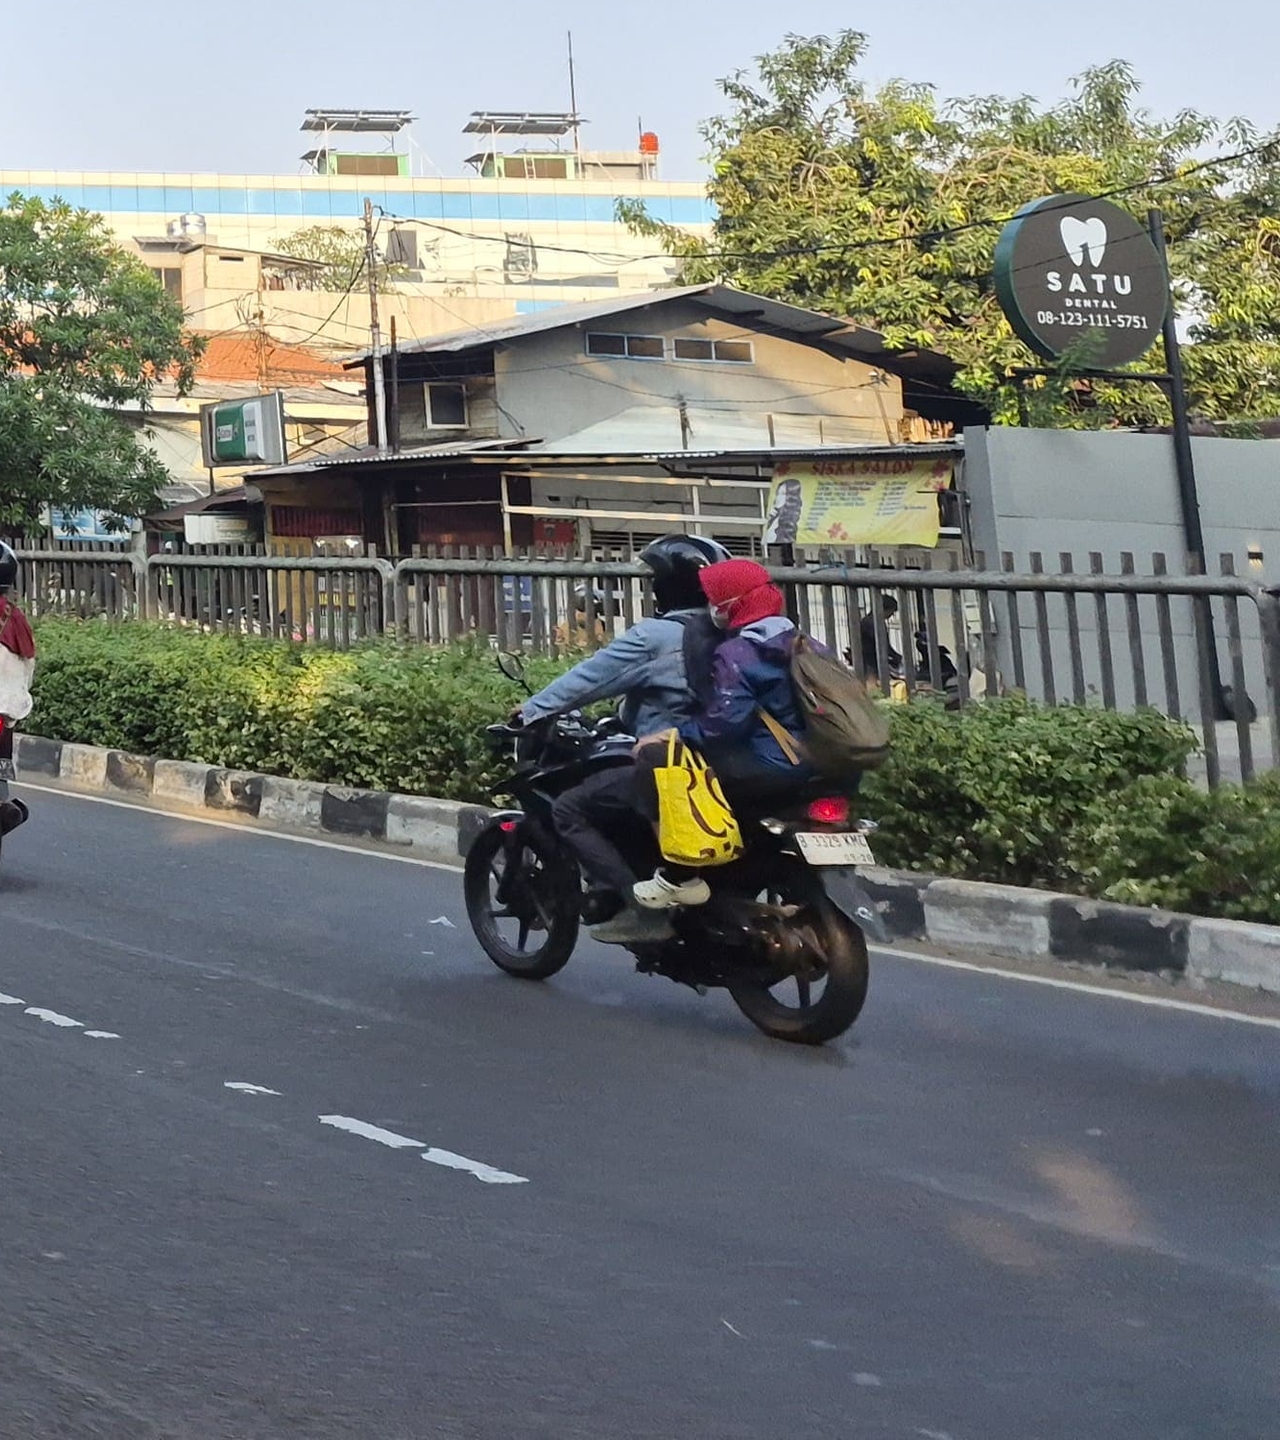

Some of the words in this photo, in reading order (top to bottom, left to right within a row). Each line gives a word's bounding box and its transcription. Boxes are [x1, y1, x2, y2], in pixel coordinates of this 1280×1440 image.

[1046, 271, 1131, 295] SATU
[1065, 298, 1117, 309] DENTAL
[1037, 310, 1148, 329] 08-123-111-5751
[798, 835, 807, 849] B
